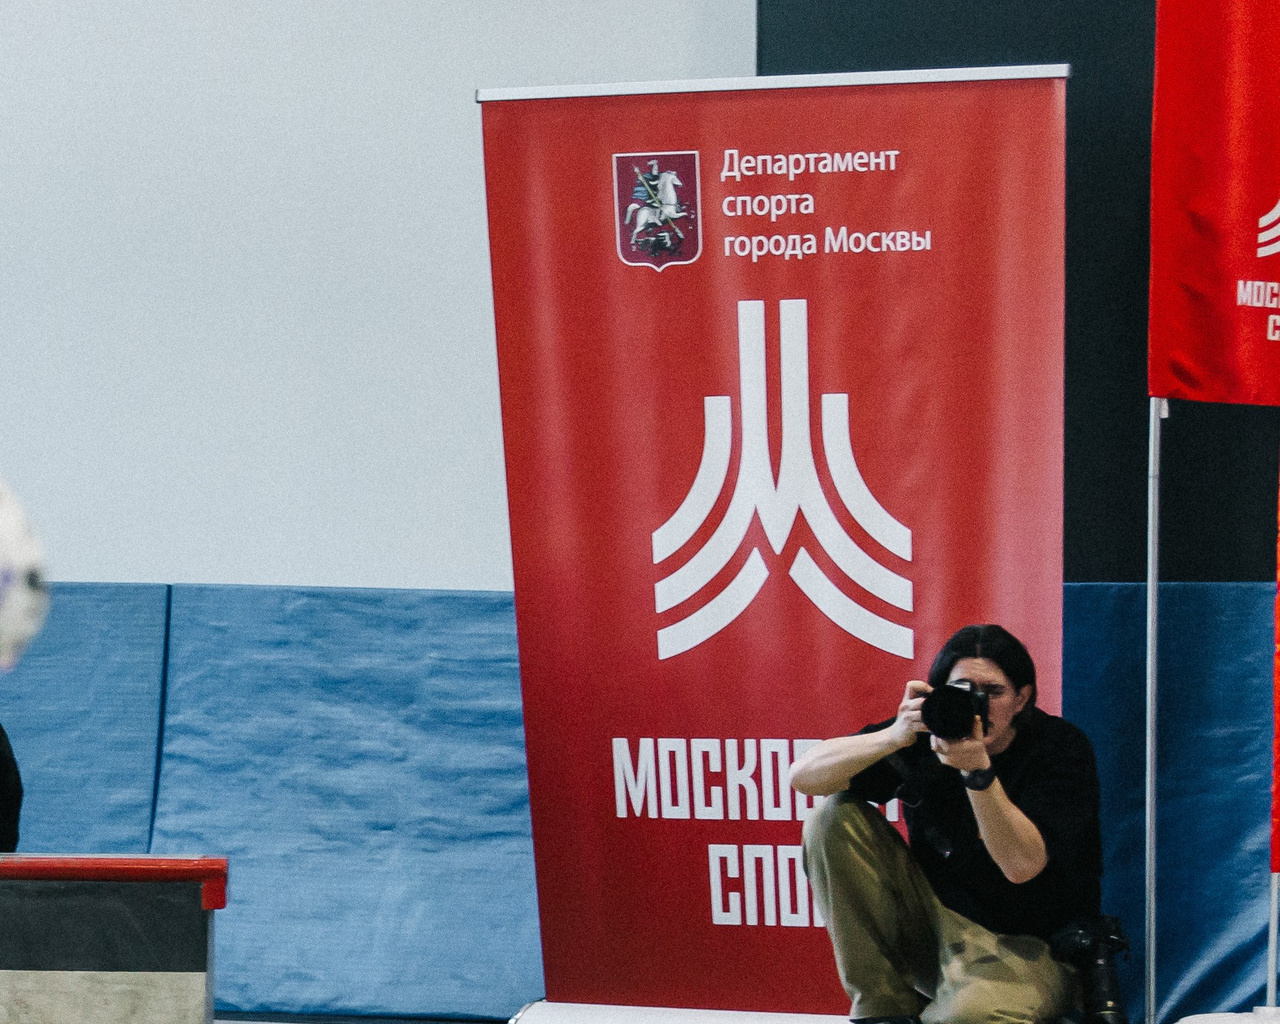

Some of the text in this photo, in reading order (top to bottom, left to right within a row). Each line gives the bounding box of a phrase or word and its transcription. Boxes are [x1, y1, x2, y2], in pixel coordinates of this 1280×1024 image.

[720, 149, 900, 182] Департамент
[722, 193, 815, 222] спорта
[723, 226, 932, 262] города Москвы
[1237, 280, 1280, 308] МОС
[708, 844, 826, 927] СПО
